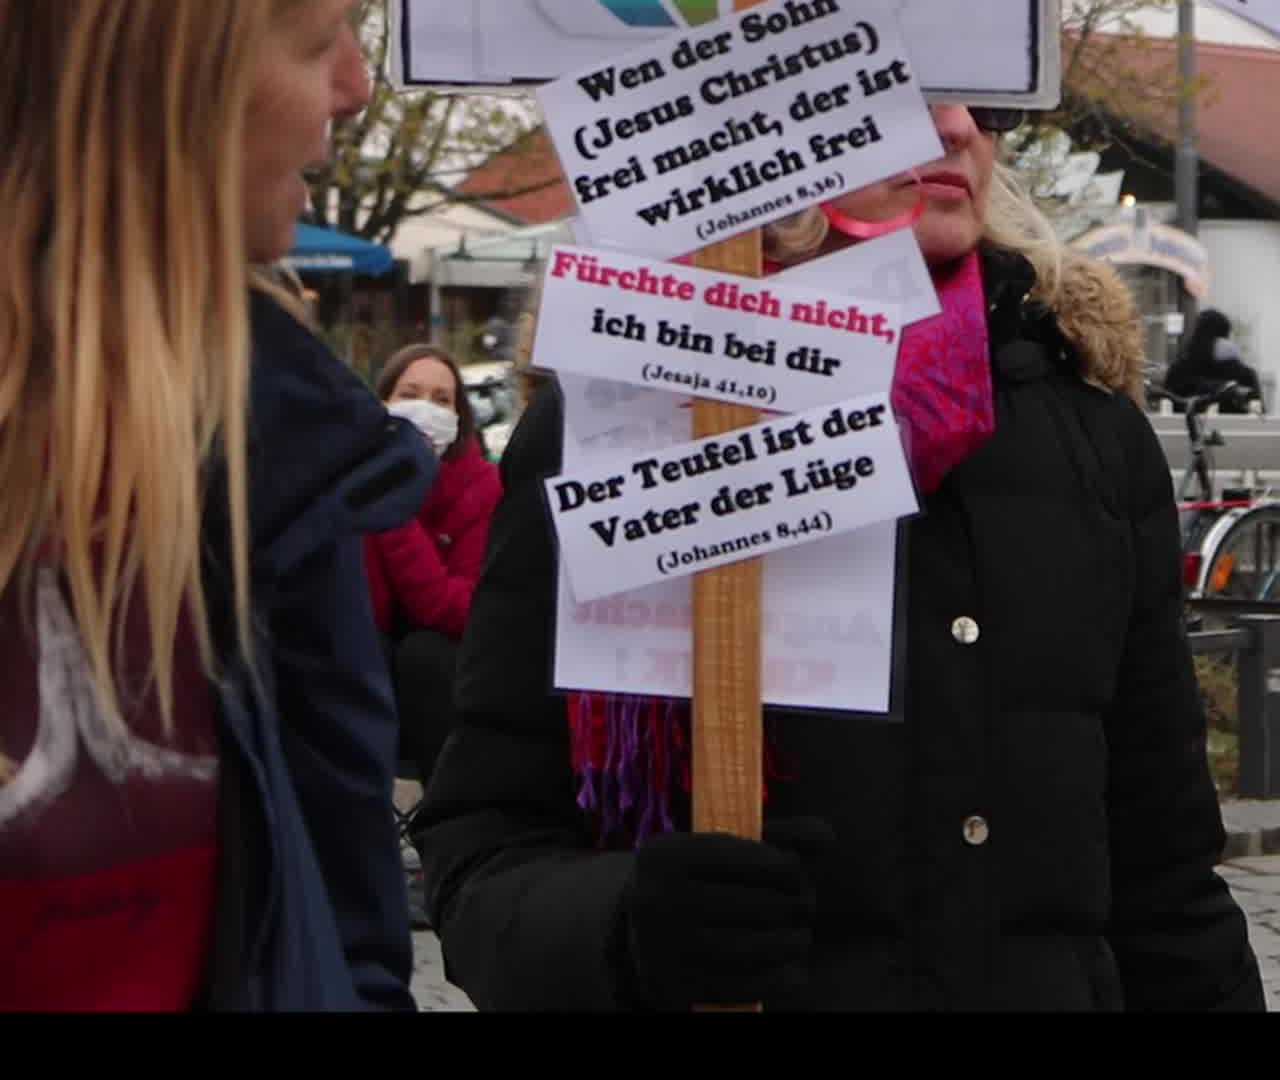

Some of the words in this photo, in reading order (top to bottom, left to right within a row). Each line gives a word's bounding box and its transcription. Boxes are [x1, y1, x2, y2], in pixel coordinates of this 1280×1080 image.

[575, 95, 694, 160] (Jesus
[700, 22, 878, 104] Christus)
[577, 59, 666, 101] Wen
[672, 32, 732, 69] der
[575, 156, 647, 203] frei
[653, 112, 783, 174] macht,
[789, 84, 850, 122] der
[858, 60, 909, 96] ist
[637, 149, 805, 226] wirklich
[809, 116, 881, 163] frei
[696, 195, 796, 240] (Johannes
[552, 252, 696, 300] Fürchte
[704, 282, 780, 317] dich
[790, 301, 895, 344] nicht,
[592, 309, 645, 341] ich
[657, 321, 712, 354] bin
[724, 333, 776, 365] bei
[786, 347, 840, 376] dir
[642, 364, 710, 389] (Jesaja
[554, 476, 624, 512] Der
[632, 433, 757, 488] Teufel
[762, 421, 814, 455] ist
[822, 404, 885, 438] der
[590, 502, 700, 546] Vater
[710, 482, 773, 516] der
[781, 456, 874, 496] Lüge
[657, 531, 771, 572] (Johannes
[777, 512, 832, 537] 8,44)
